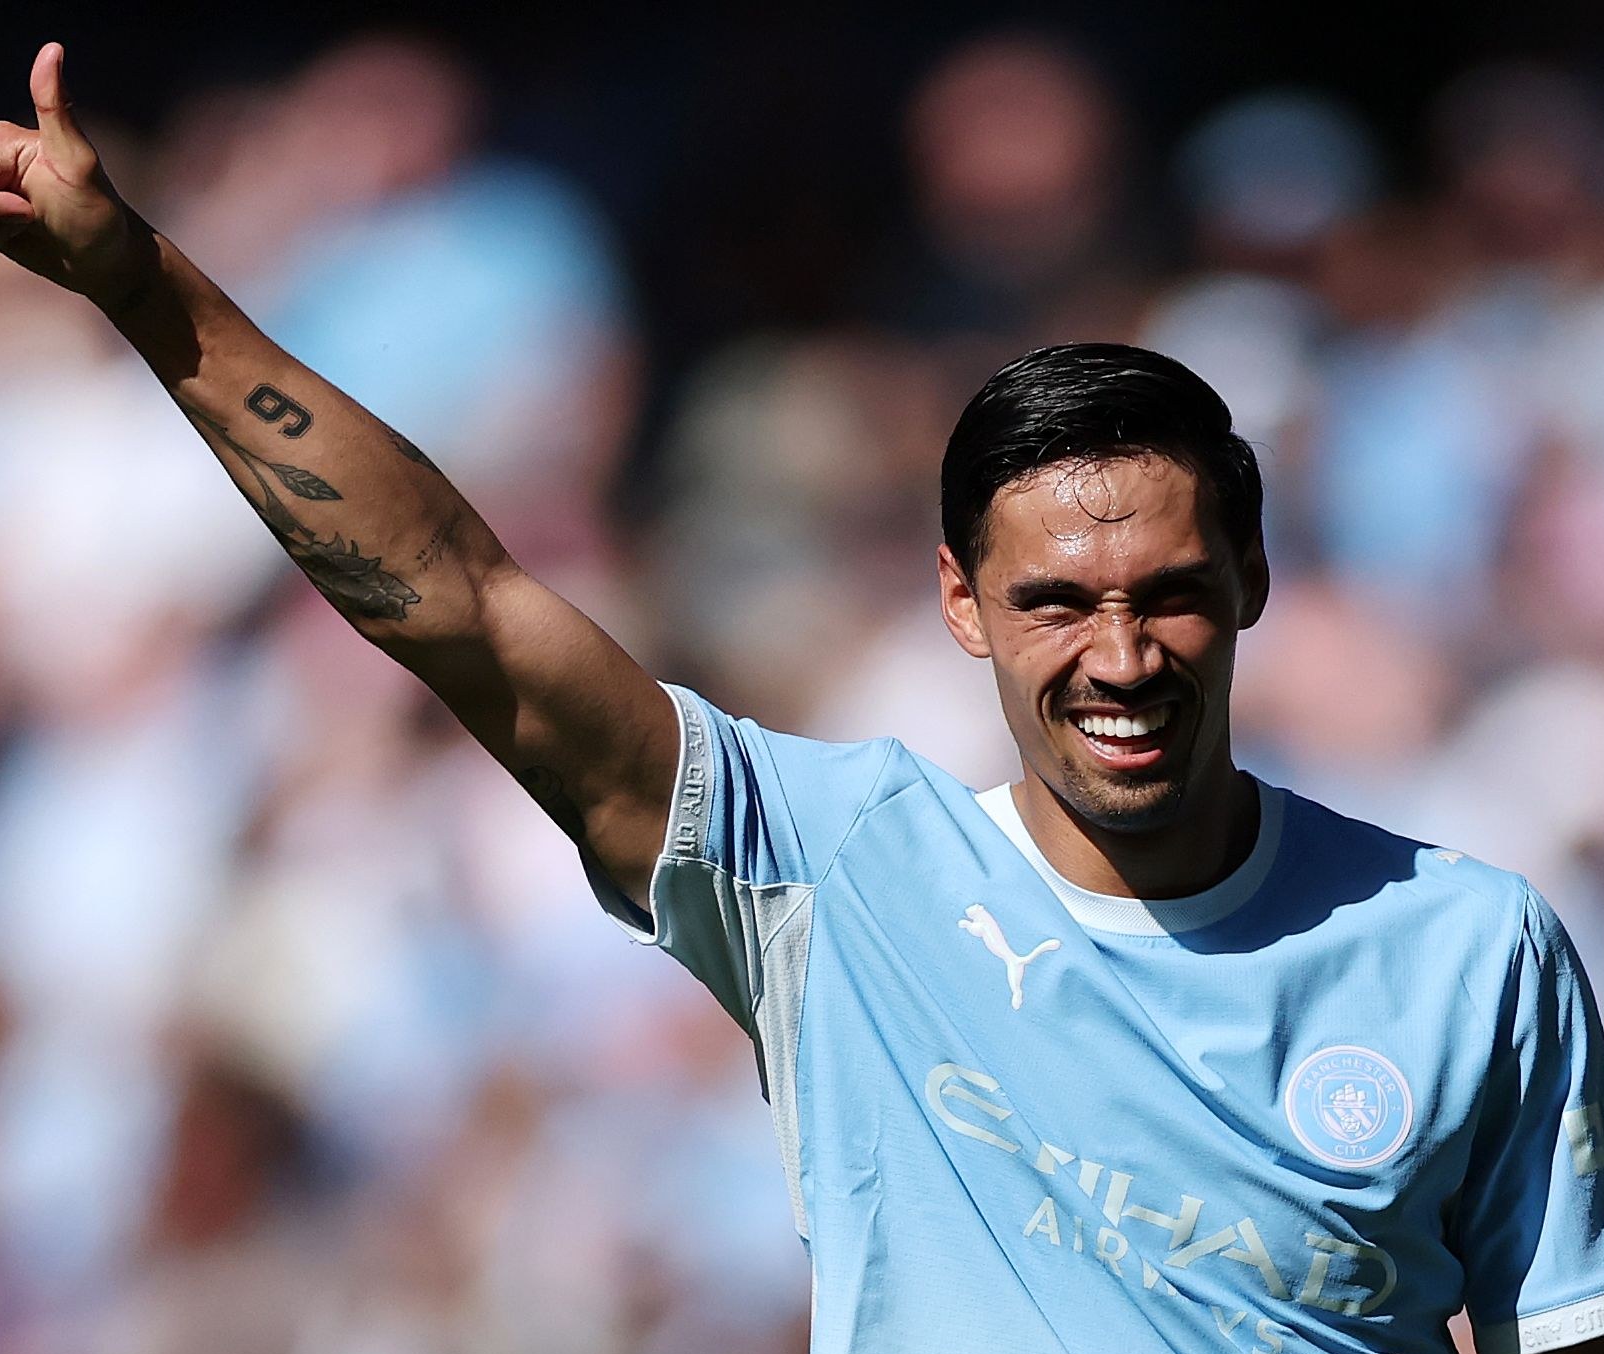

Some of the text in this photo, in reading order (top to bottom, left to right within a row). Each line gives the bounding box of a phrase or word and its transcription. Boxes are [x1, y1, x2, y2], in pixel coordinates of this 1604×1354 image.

[680, 763, 706, 817] CITY
[1302, 1057, 1397, 1094] MANCHESTER
[1335, 1144, 1368, 1156] CITY
